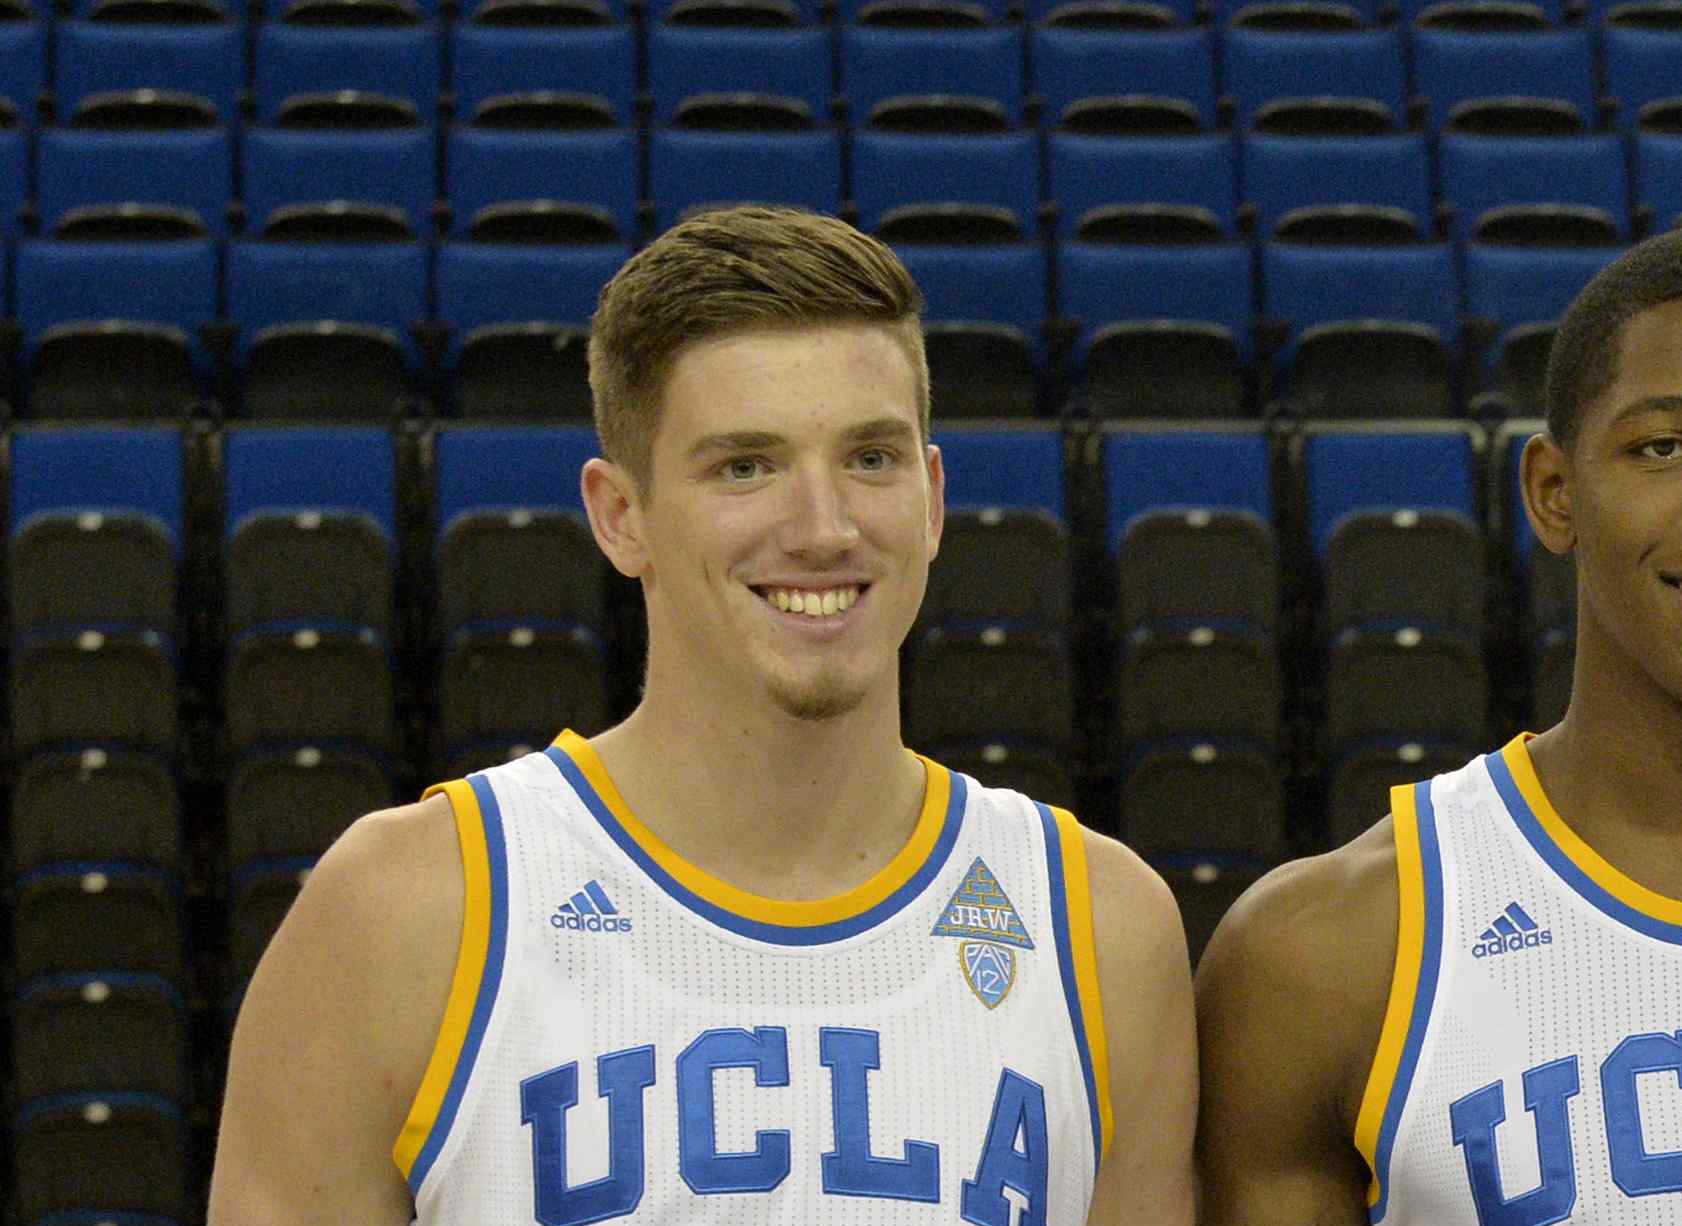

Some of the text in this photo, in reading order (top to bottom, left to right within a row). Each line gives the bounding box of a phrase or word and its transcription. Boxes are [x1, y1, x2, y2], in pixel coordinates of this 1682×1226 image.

[550, 912, 633, 932] adidas
[950, 904, 1013, 931] JRW
[1472, 929, 1552, 958] adidas
[975, 969, 1001, 995] 12
